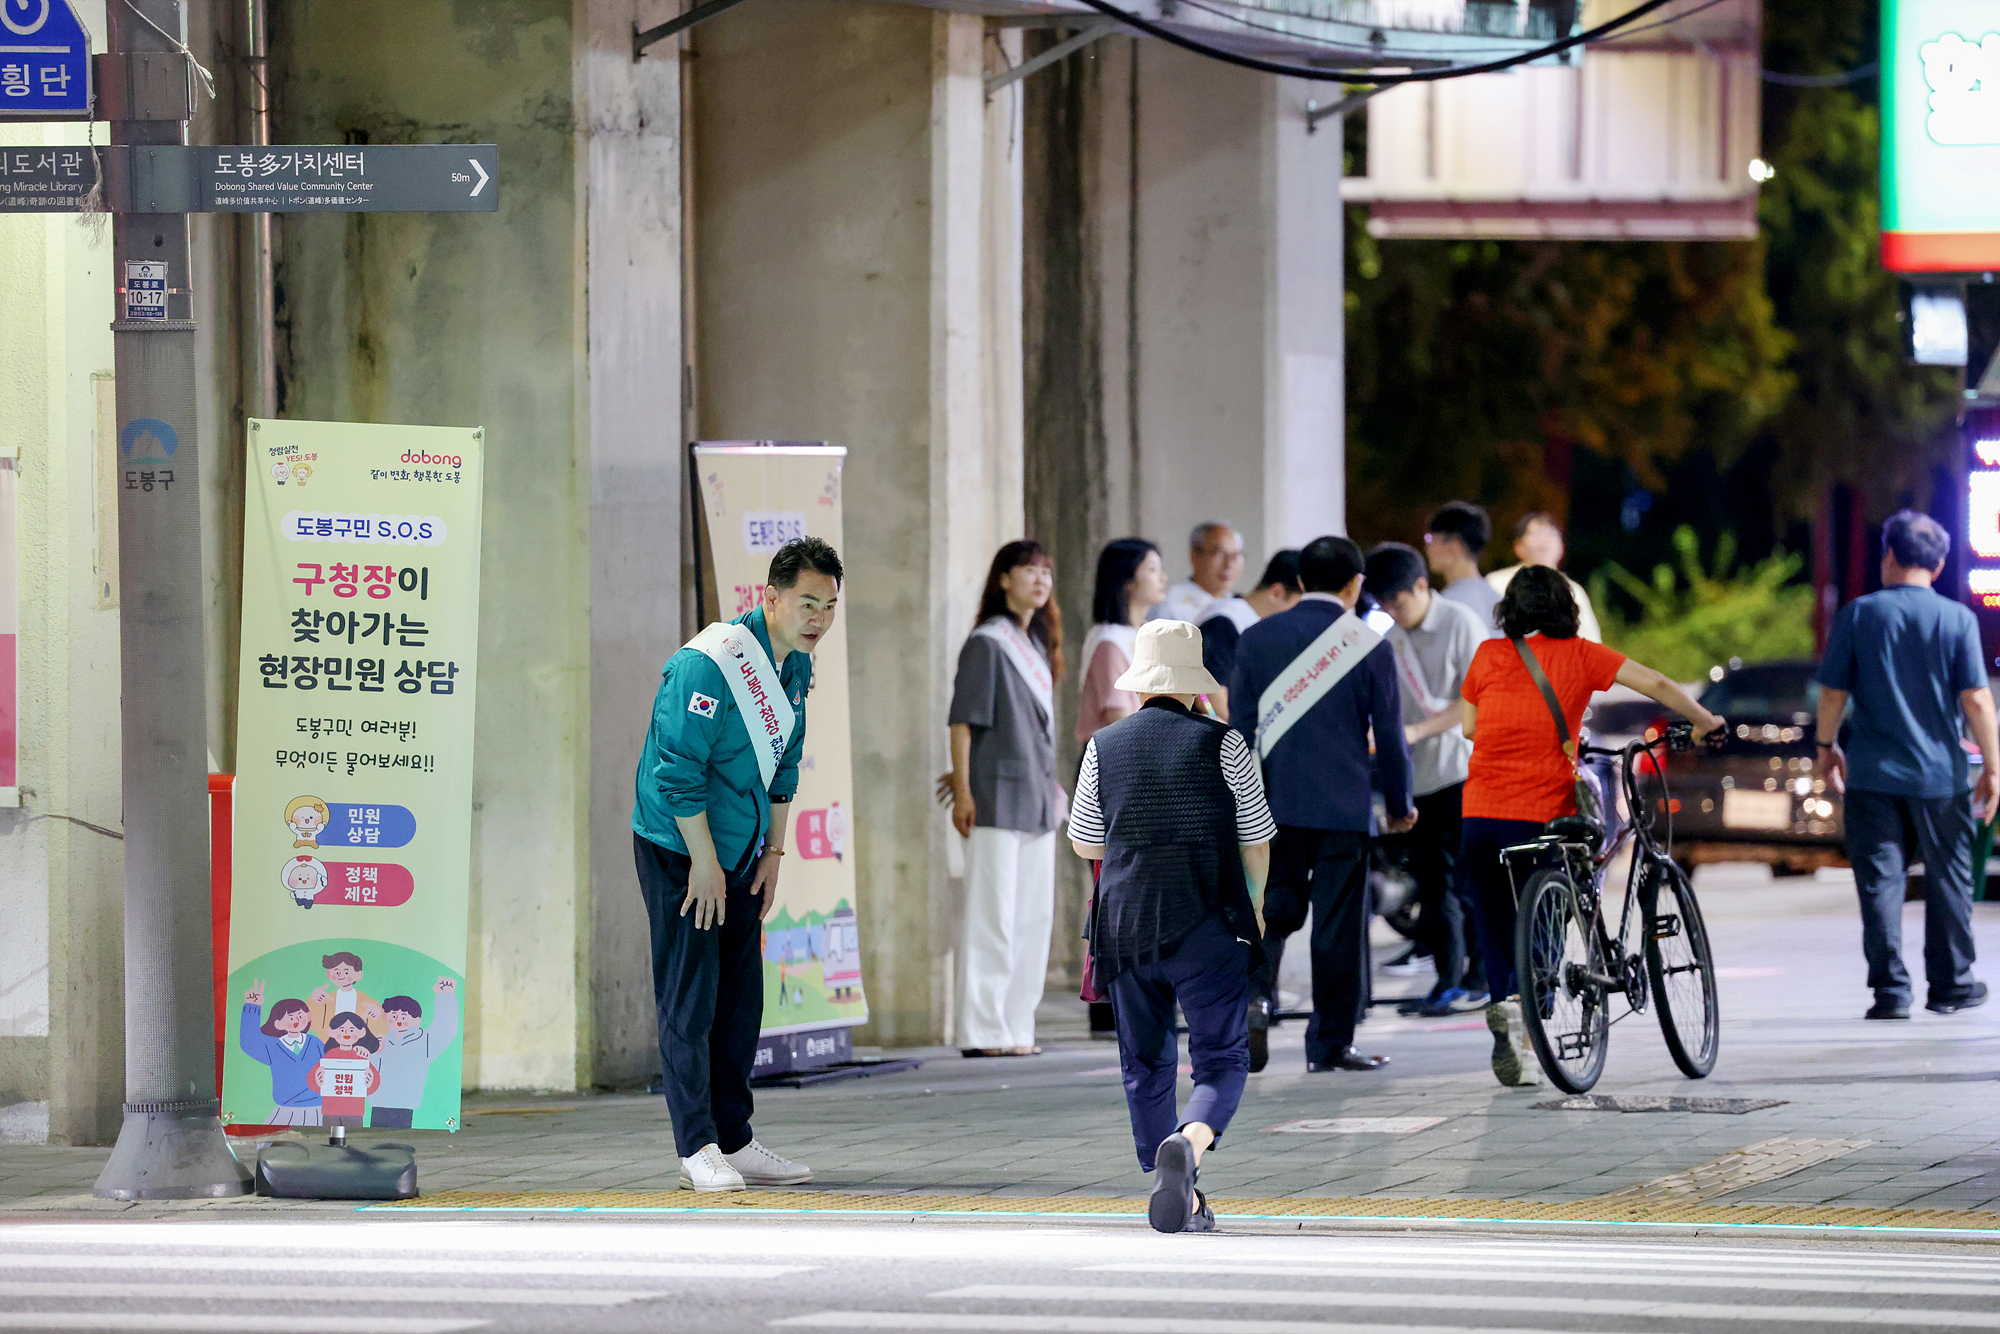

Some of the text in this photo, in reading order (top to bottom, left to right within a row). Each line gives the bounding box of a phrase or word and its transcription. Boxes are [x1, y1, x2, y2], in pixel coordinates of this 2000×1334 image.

[1, 64, 71, 97] 횡단
[214, 152, 364, 178] 도봉多가치센터
[215, 181, 374, 192] Dobong Shared Value Community Center
[451, 172, 470, 183] 50m
[13, 181, 48, 192] Miracle
[50, 181, 84, 195] Library
[130, 291, 163, 305] 10-17
[286, 452, 319, 462] YES! 도봉
[400, 448, 462, 469] dobong
[125, 470, 175, 492] 도봉구
[370, 469, 388, 480] 같이
[413, 468, 443, 483] 행복한
[445, 470, 461, 484] 도봉
[296, 516, 433, 540] 도봉구민 S.O.S
[292, 562, 429, 601] 구청장이
[290, 607, 429, 647] 찾아가는
[258, 653, 460, 695] 현장민원 상담
[739, 661, 780, 736] 도봉구청장
[296, 717, 417, 743] 도봉구민 여러분!
[275, 749, 434, 776] 무엇이든 물어보세요!!
[348, 807, 381, 825] 민원
[346, 826, 381, 844] 상담
[345, 866, 378, 884] 정책
[344, 885, 378, 903] 제안
[334, 1073, 354, 1084] 민원
[334, 1085, 354, 1096] 정책
